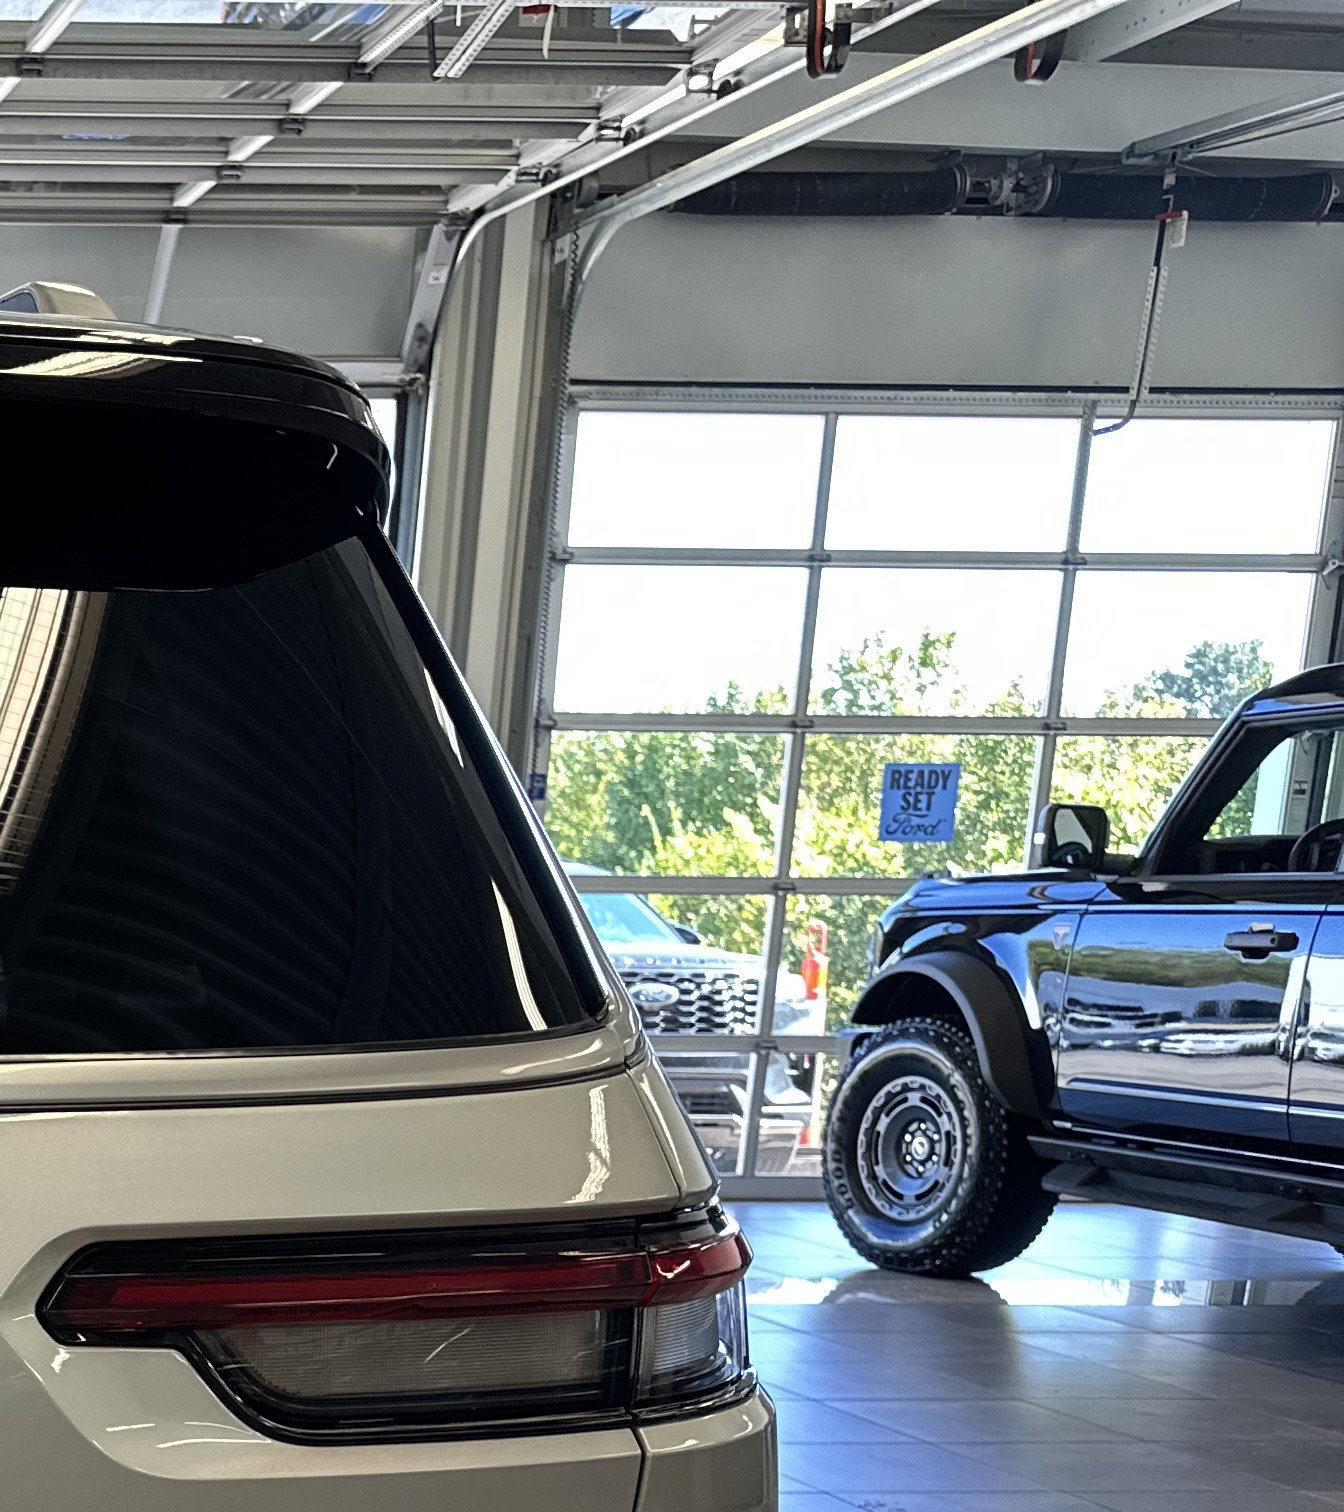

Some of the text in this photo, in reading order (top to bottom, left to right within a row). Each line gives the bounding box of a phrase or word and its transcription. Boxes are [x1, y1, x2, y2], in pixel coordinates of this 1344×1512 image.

[889, 769, 953, 790] READY
[900, 791, 935, 812] SET
[885, 812, 945, 837] Ford
